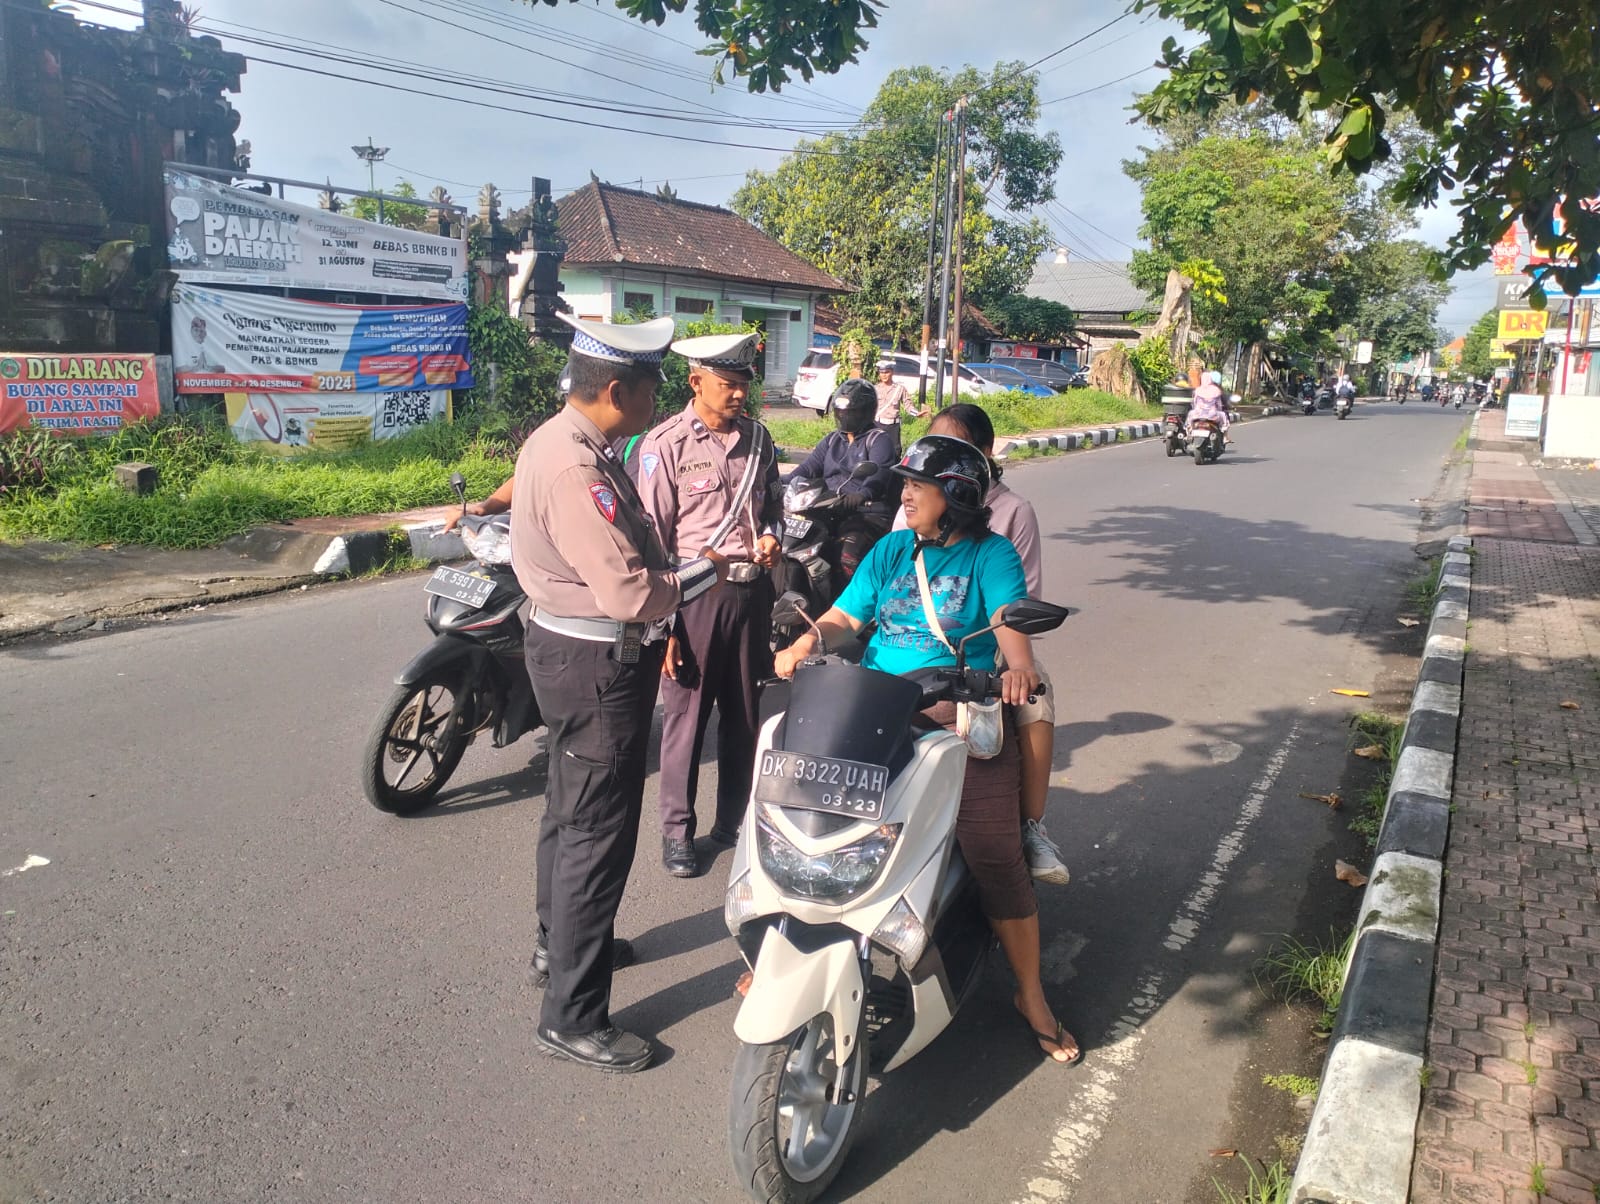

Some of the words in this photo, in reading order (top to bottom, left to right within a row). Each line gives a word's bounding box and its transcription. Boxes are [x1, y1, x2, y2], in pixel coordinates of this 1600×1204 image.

[204, 212, 302, 243] PAJAK
[204, 236, 303, 263] DAERAH
[322, 238, 332, 247] 12
[373, 240, 409, 253] BEBAS
[412, 243, 448, 256] BBNKB
[319, 256, 326, 265] 31
[329, 256, 365, 266] AGUSTUS
[238, 334, 296, 345] MANFAATKAN
[282, 346, 308, 354] PAJAK
[251, 355, 272, 365] PKB
[285, 356, 318, 366] BBNKB
[26, 357, 144, 381] DILARANG
[183, 378, 232, 387] NOVEMBER
[260, 379, 303, 388] DESEMBER
[318, 375, 352, 390] 2024
[7, 383, 68, 398] BUANG
[71, 383, 138, 398] SAMPAH
[26, 400, 46, 413] DI
[50, 399, 97, 413] AREA
[99, 399, 123, 411] INI
[694, 461, 713, 471] PUTRA
[450, 572, 475, 589] 5991
[761, 755, 787, 777] DK
[794, 759, 841, 785] 3322
[845, 766, 884, 793] UAH
